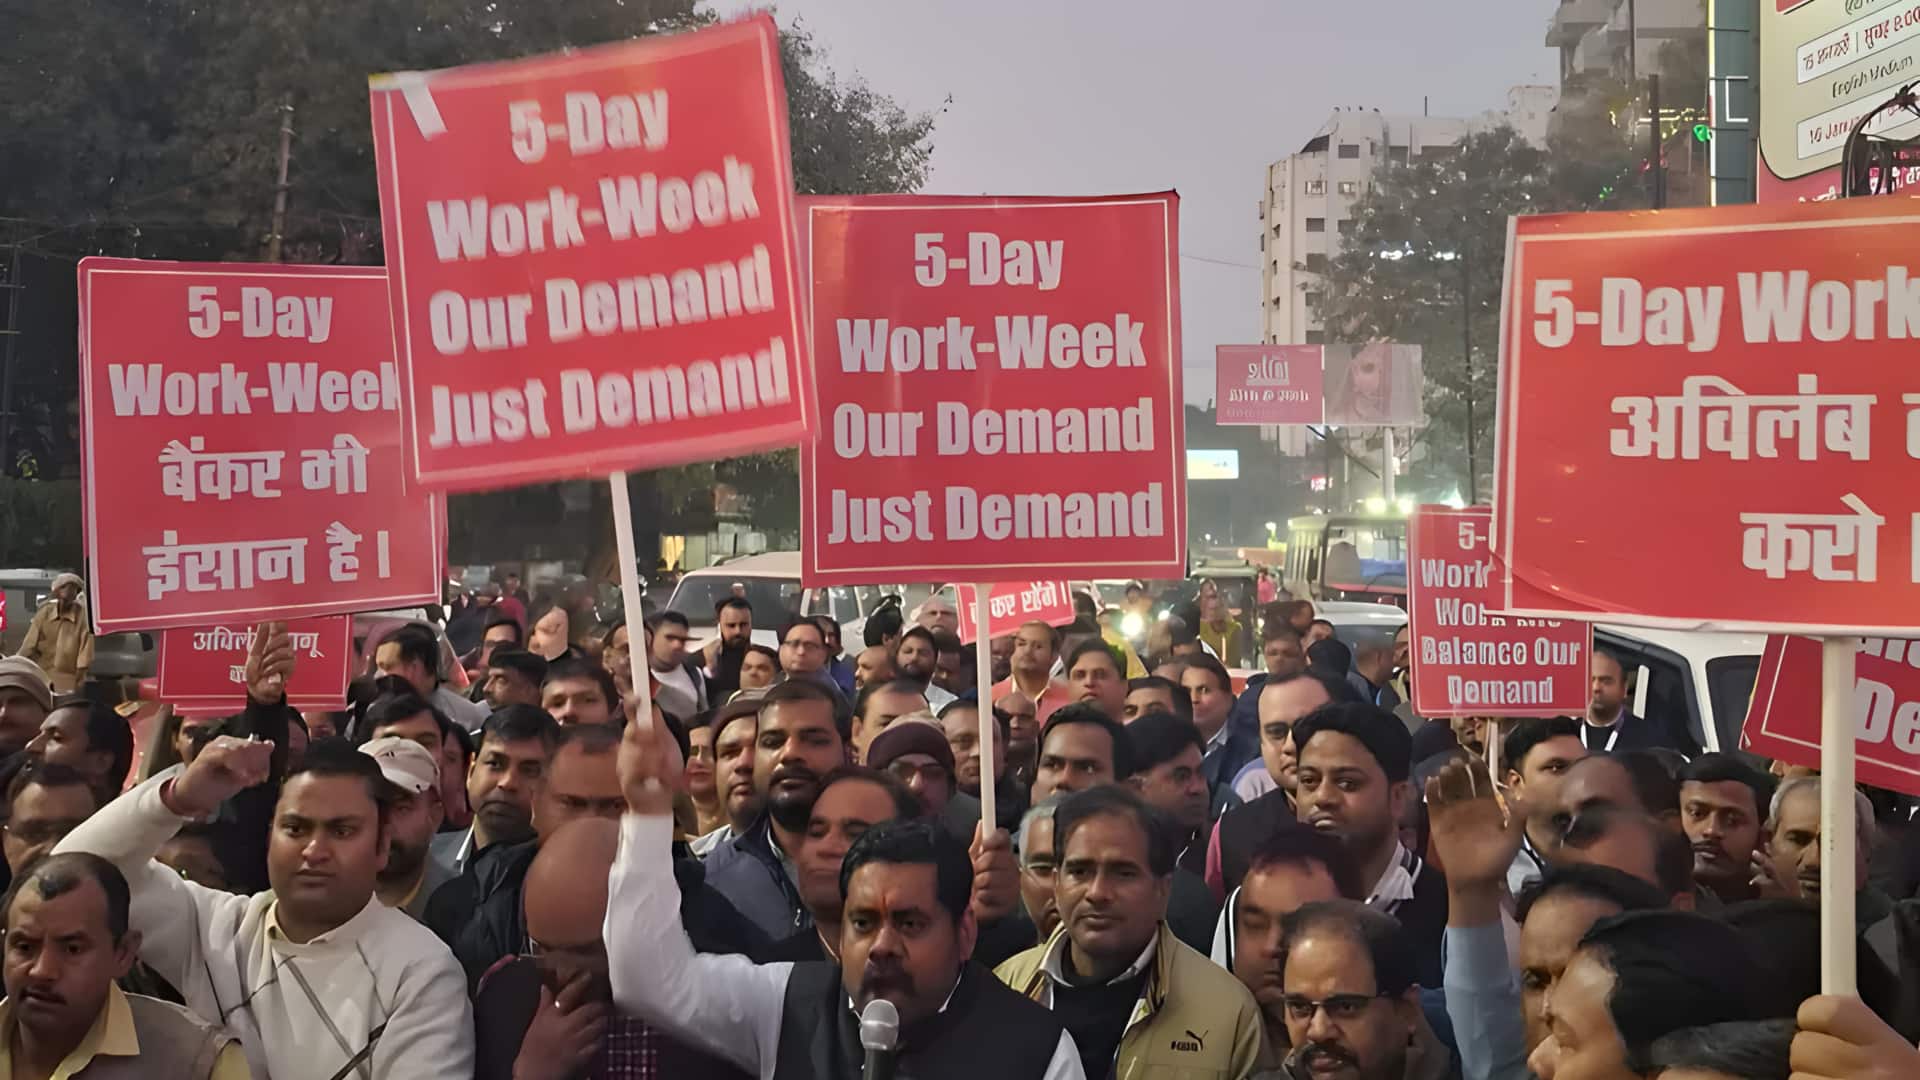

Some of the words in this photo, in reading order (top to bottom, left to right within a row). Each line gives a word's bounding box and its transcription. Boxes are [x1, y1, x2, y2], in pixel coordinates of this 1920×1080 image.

[509, 89, 669, 163] 5-Day
[426, 155, 760, 263] Work-Week
[914, 232, 1064, 290] 5-Day
[188, 286, 333, 343] 5-Day
[429, 290, 532, 355] Our
[545, 243, 775, 343] Demand
[1533, 277, 1724, 352] 5-Day
[836, 313, 1147, 373] Work-Week
[429, 378, 551, 449] Just
[560, 336, 791, 434] Demand
[1610, 373, 1877, 461] अविलंब
[833, 402, 923, 458] Our
[937, 397, 1154, 456] Demand
[158, 437, 284, 500] बैंकर
[301, 434, 369, 493] भी
[828, 489, 933, 544] Just
[945, 482, 1164, 541] Demand
[1740, 492, 1886, 582] करो
[142, 530, 307, 600] इंसान
[1421, 636, 1527, 665] Balance
[1534, 637, 1581, 666] Our
[1448, 675, 1553, 704] Demand
